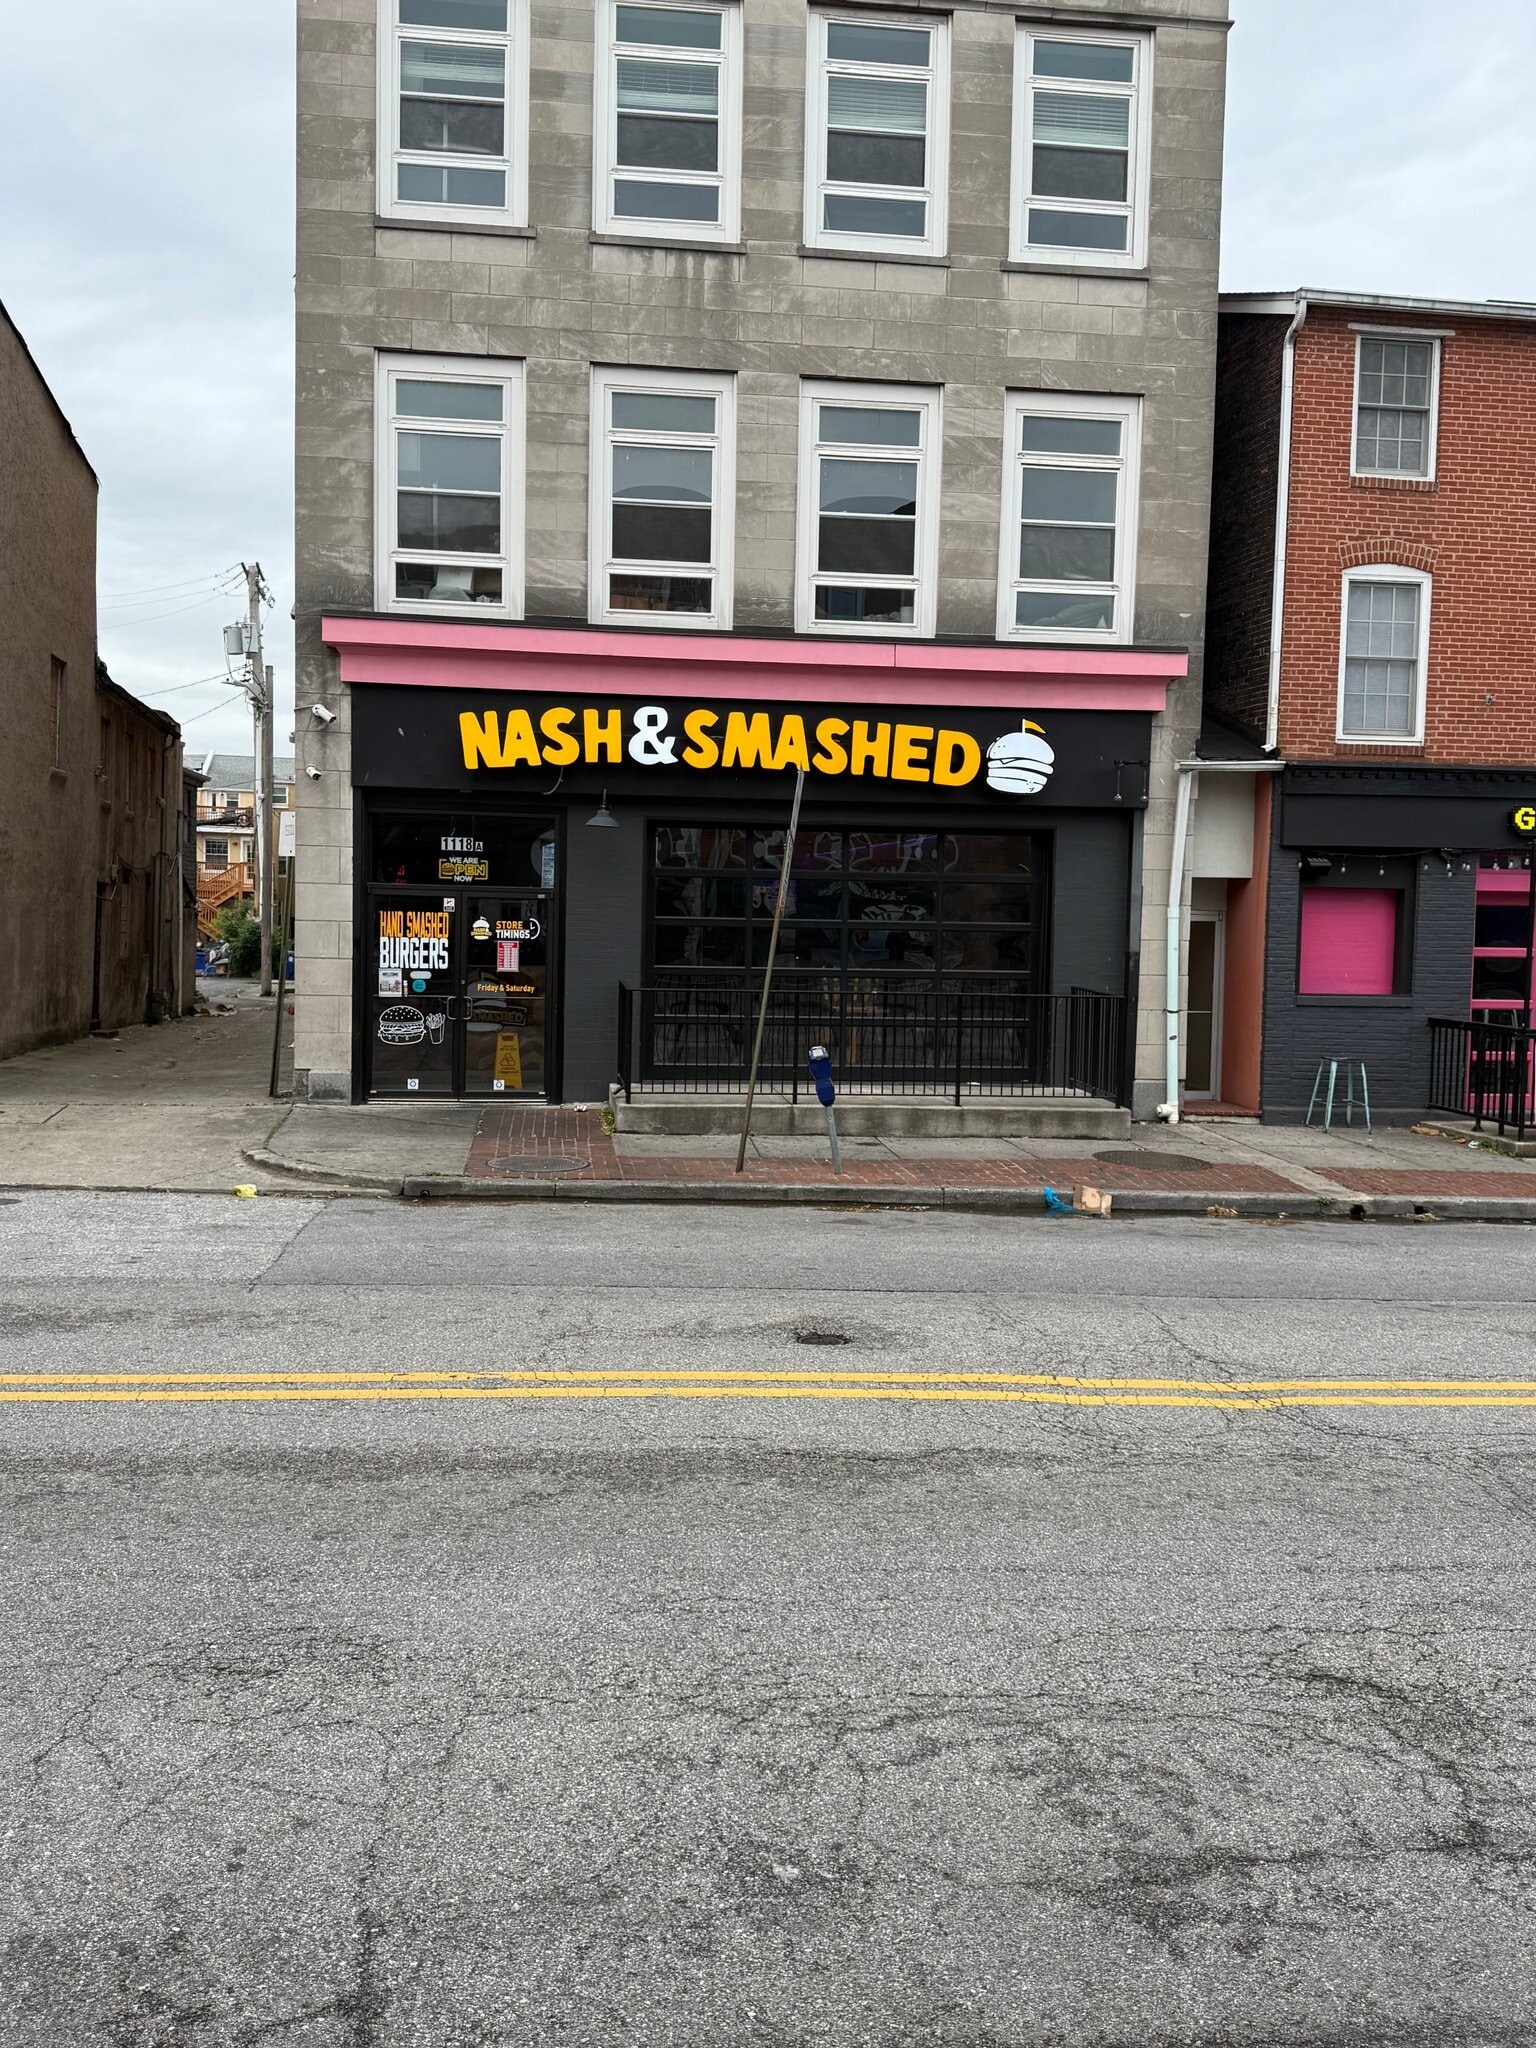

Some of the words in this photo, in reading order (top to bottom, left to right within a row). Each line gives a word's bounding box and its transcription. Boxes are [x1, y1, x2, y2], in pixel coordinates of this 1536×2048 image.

[459, 706, 622, 770] NASH
[627, 706, 678, 765] &
[682, 709, 982, 788] SMASHED
[463, 857, 479, 865] ARE
[379, 911, 403, 938] HAND
[406, 911, 449, 939] SMASHED
[495, 921, 524, 930] STORE
[495, 929, 531, 939] TIMINGS
[379, 937, 449, 969] BURGERS
[477, 984, 499, 993] Friday
[505, 984, 536, 994] Saturday
